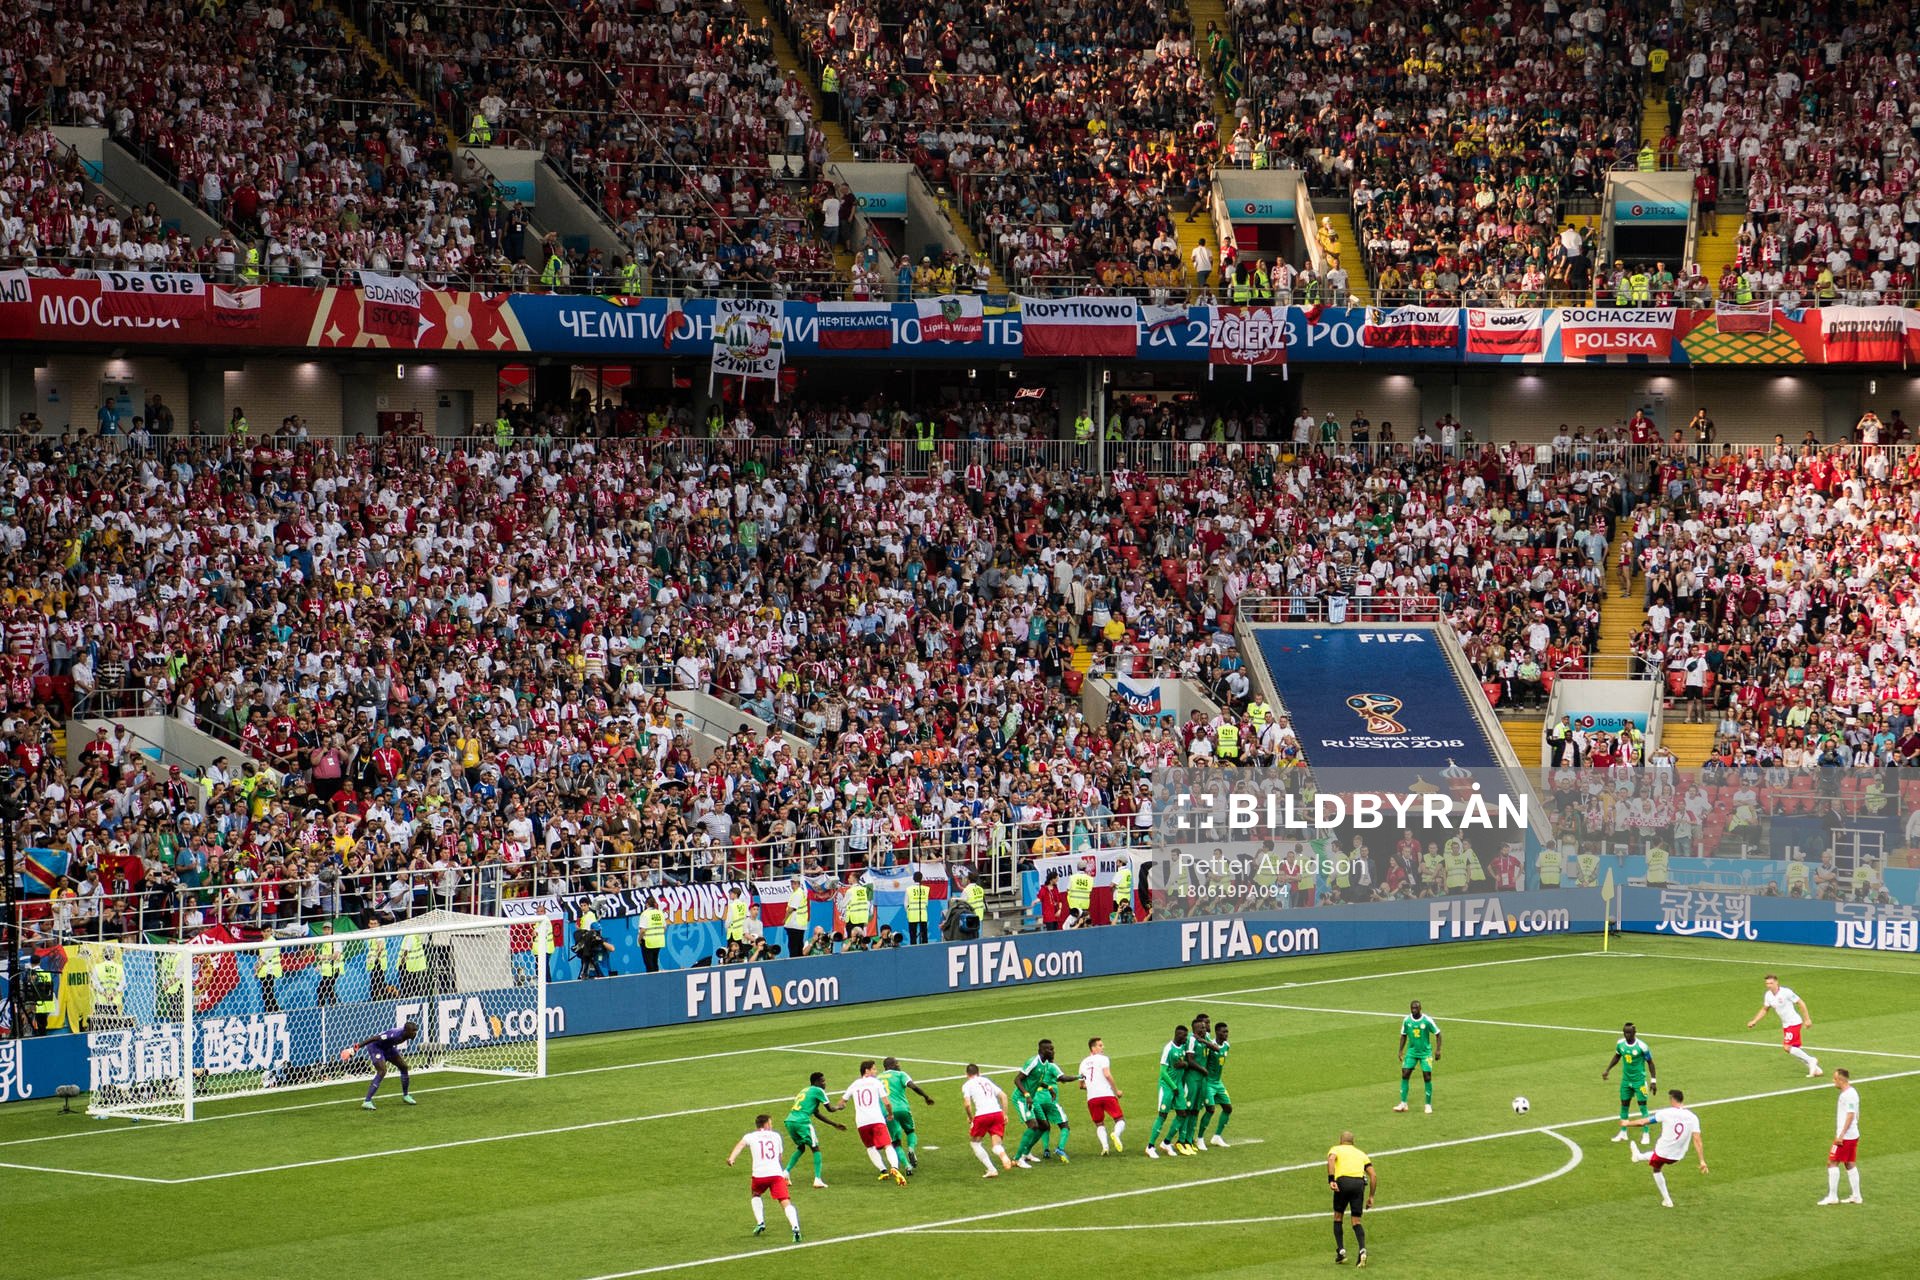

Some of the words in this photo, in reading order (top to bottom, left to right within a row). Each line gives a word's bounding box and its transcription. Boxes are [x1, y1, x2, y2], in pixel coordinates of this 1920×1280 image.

[869, 198, 887, 208] 210
[1258, 204, 1273, 214] 211
[1645, 206, 1676, 215] 211-212
[109, 272, 145, 291] De
[150, 274, 194, 294] Gie
[1025, 302, 1133, 319] KOPYTKOWO
[1390, 311, 1439, 324] BYTOM
[1562, 309, 1673, 323] SOCHACZEW
[818, 314, 889, 327] НЕФТЕКАМСК
[1210, 319, 1287, 350] ZGIERZ
[1575, 332, 1657, 349] POLSKA
[1358, 633, 1425, 644] FIFA
[1597, 718, 1627, 727] 108-10
[1321, 739, 1409, 749] RUSSIA
[1412, 739, 1465, 748] 2018
[505, 899, 561, 917] POLSKA
[1087, 1066, 1095, 1082] 7
[857, 1088, 873, 1107] 10
[1674, 1122, 1685, 1140] 9
[758, 1140, 776, 1160] 13
